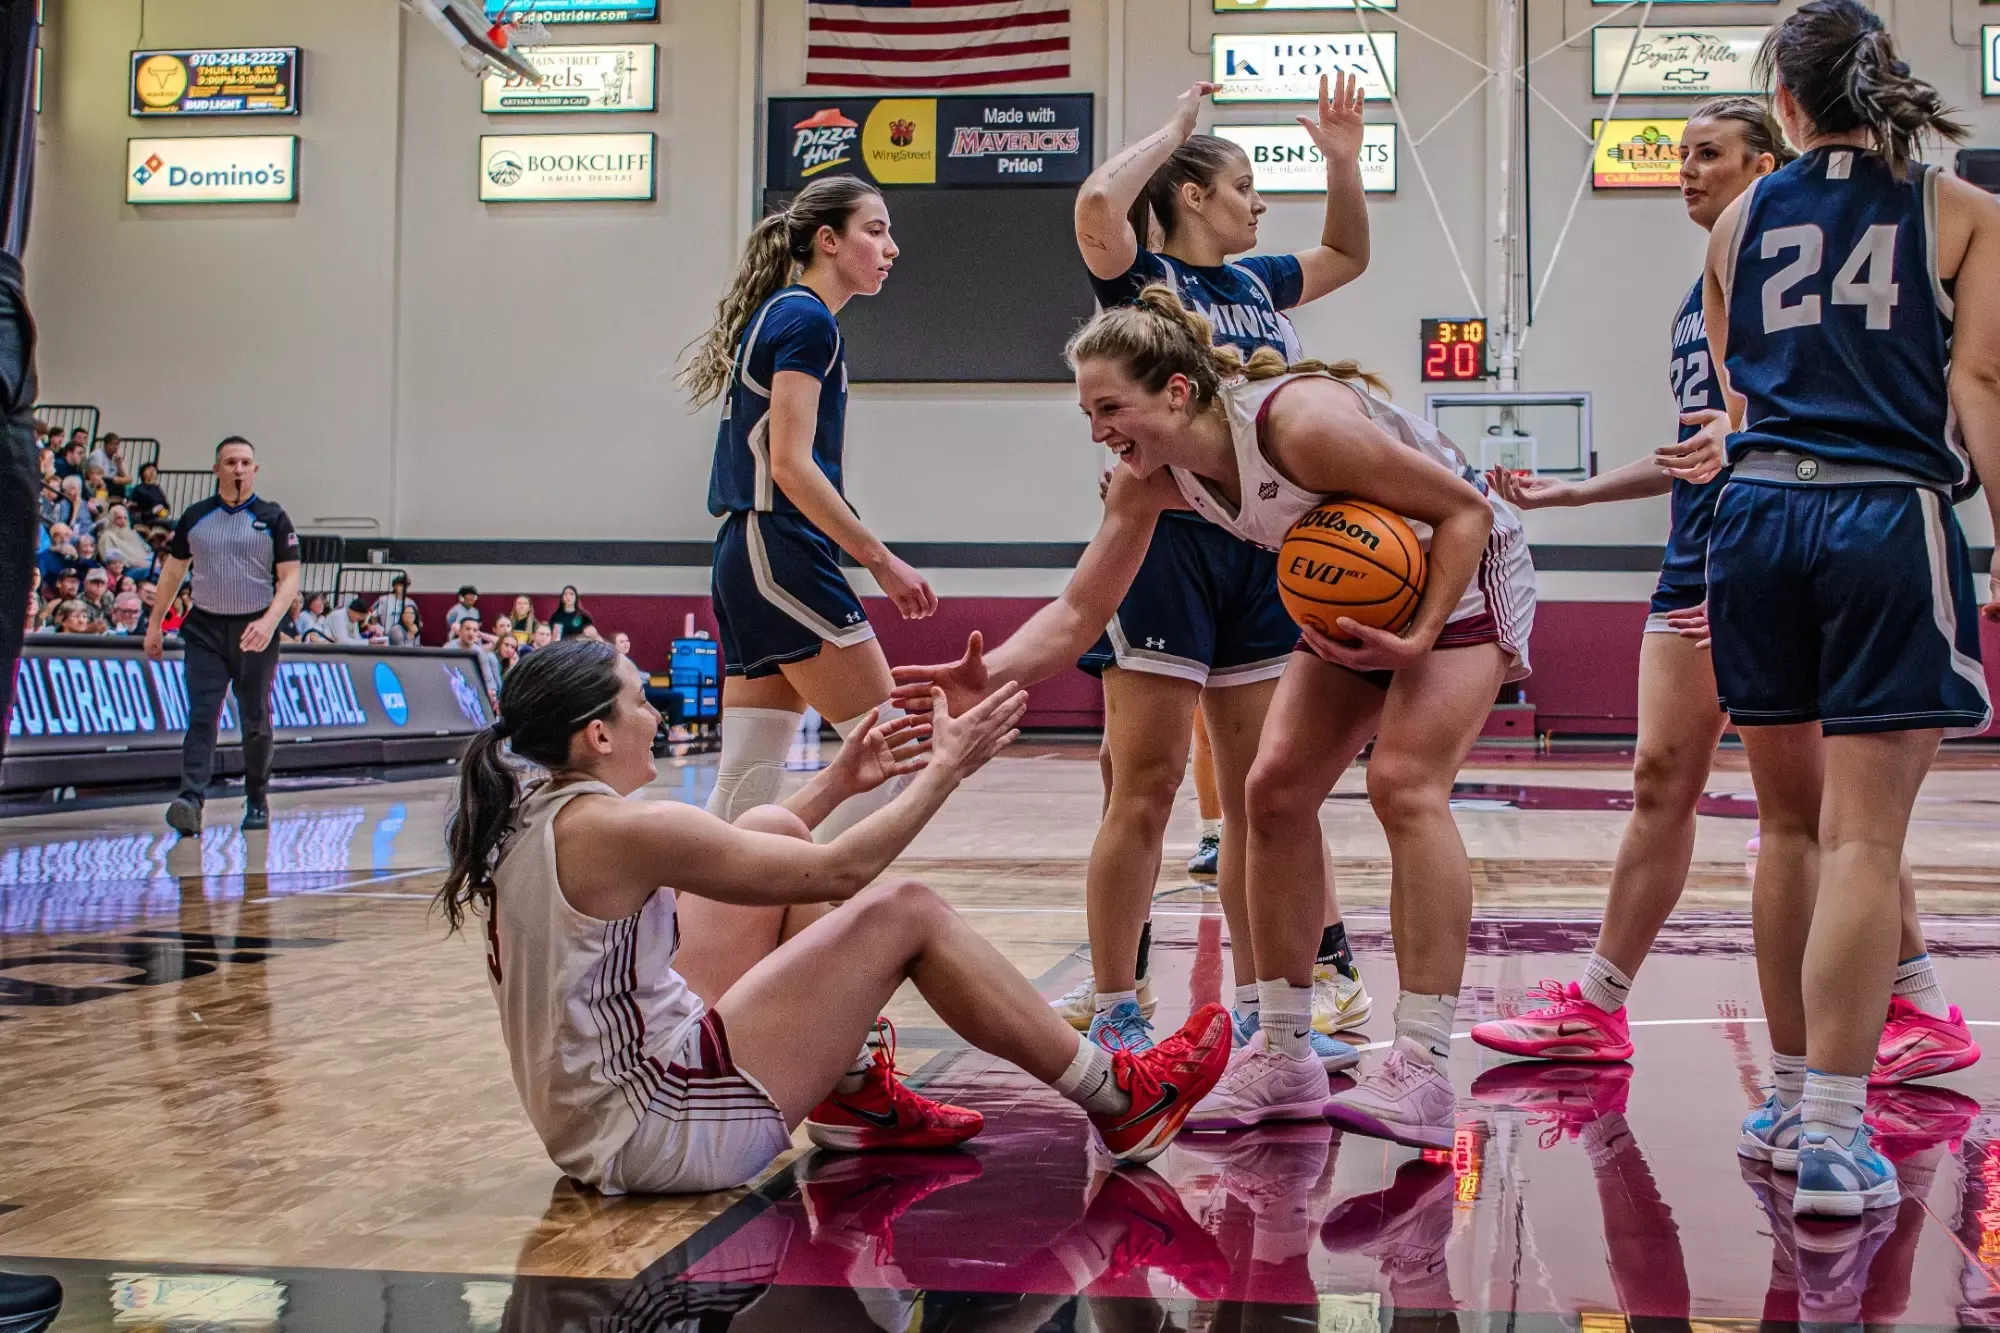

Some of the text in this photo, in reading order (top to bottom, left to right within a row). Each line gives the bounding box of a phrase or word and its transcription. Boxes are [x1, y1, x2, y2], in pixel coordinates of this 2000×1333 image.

[190, 52, 286, 66] 970-248-2222
[1274, 44, 1375, 57] HOME
[1692, 43, 1741, 64] Miller
[559, 56, 600, 66] STREET
[1278, 64, 1369, 76] LOAN
[198, 66, 230, 76] THUR.
[256, 65, 278, 74] SAT.
[185, 100, 208, 110] BUD
[210, 99, 242, 110] LIGHT
[984, 107, 1056, 123] Made with
[792, 127, 857, 157] Pizza
[949, 127, 1079, 157] MAVERICKS
[528, 154, 649, 172] BOOKCLIFF
[802, 142, 850, 168] Hut
[872, 150, 932, 161] WingStreet
[1254, 146, 1304, 163] BSN
[997, 158, 1043, 173] Pride!
[169, 163, 285, 187] Domino's
[1761, 223, 1899, 334] 24
[1439, 322, 1482, 343] 3:10
[1426, 343, 1474, 377] 20
[1289, 556, 1345, 586] EVO
[9, 658, 155, 735] OLORADO
